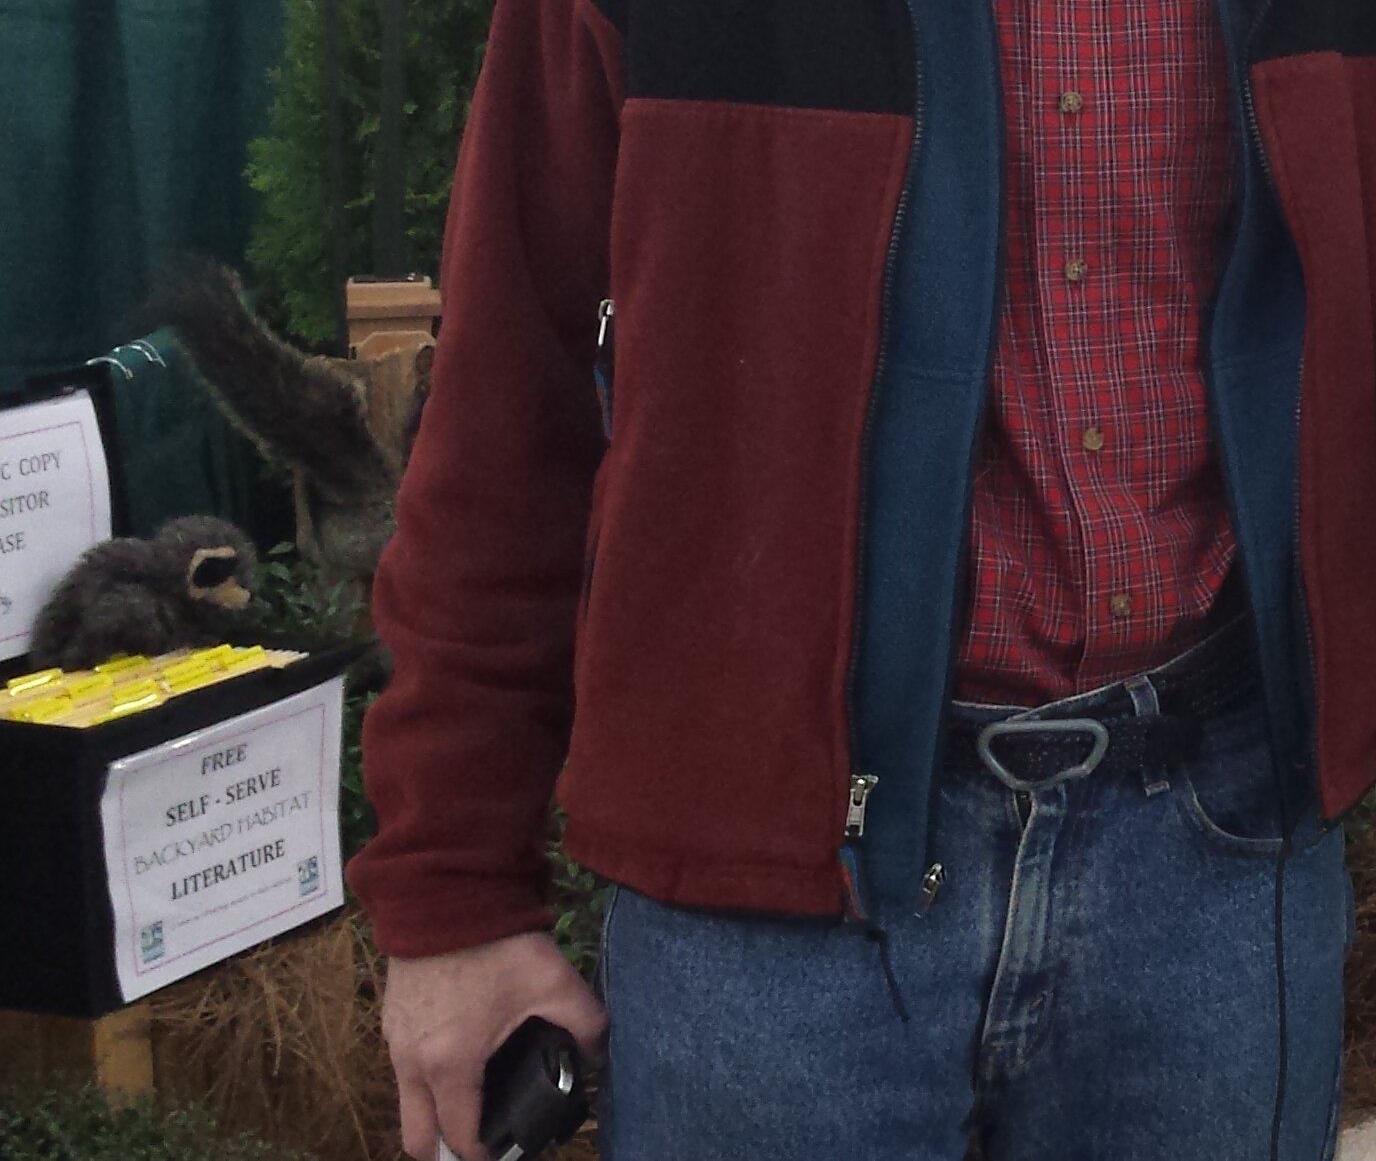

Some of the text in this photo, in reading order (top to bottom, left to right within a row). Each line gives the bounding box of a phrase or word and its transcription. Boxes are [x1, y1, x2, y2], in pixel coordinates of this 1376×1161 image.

[18, 450, 63, 477] COPY
[201, 743, 248, 776] FREE
[165, 793, 211, 828] SELF
[224, 767, 282, 806] SERVE
[133, 790, 313, 876] BACKYARD HABITAT
[170, 838, 287, 902] LITERATURE
